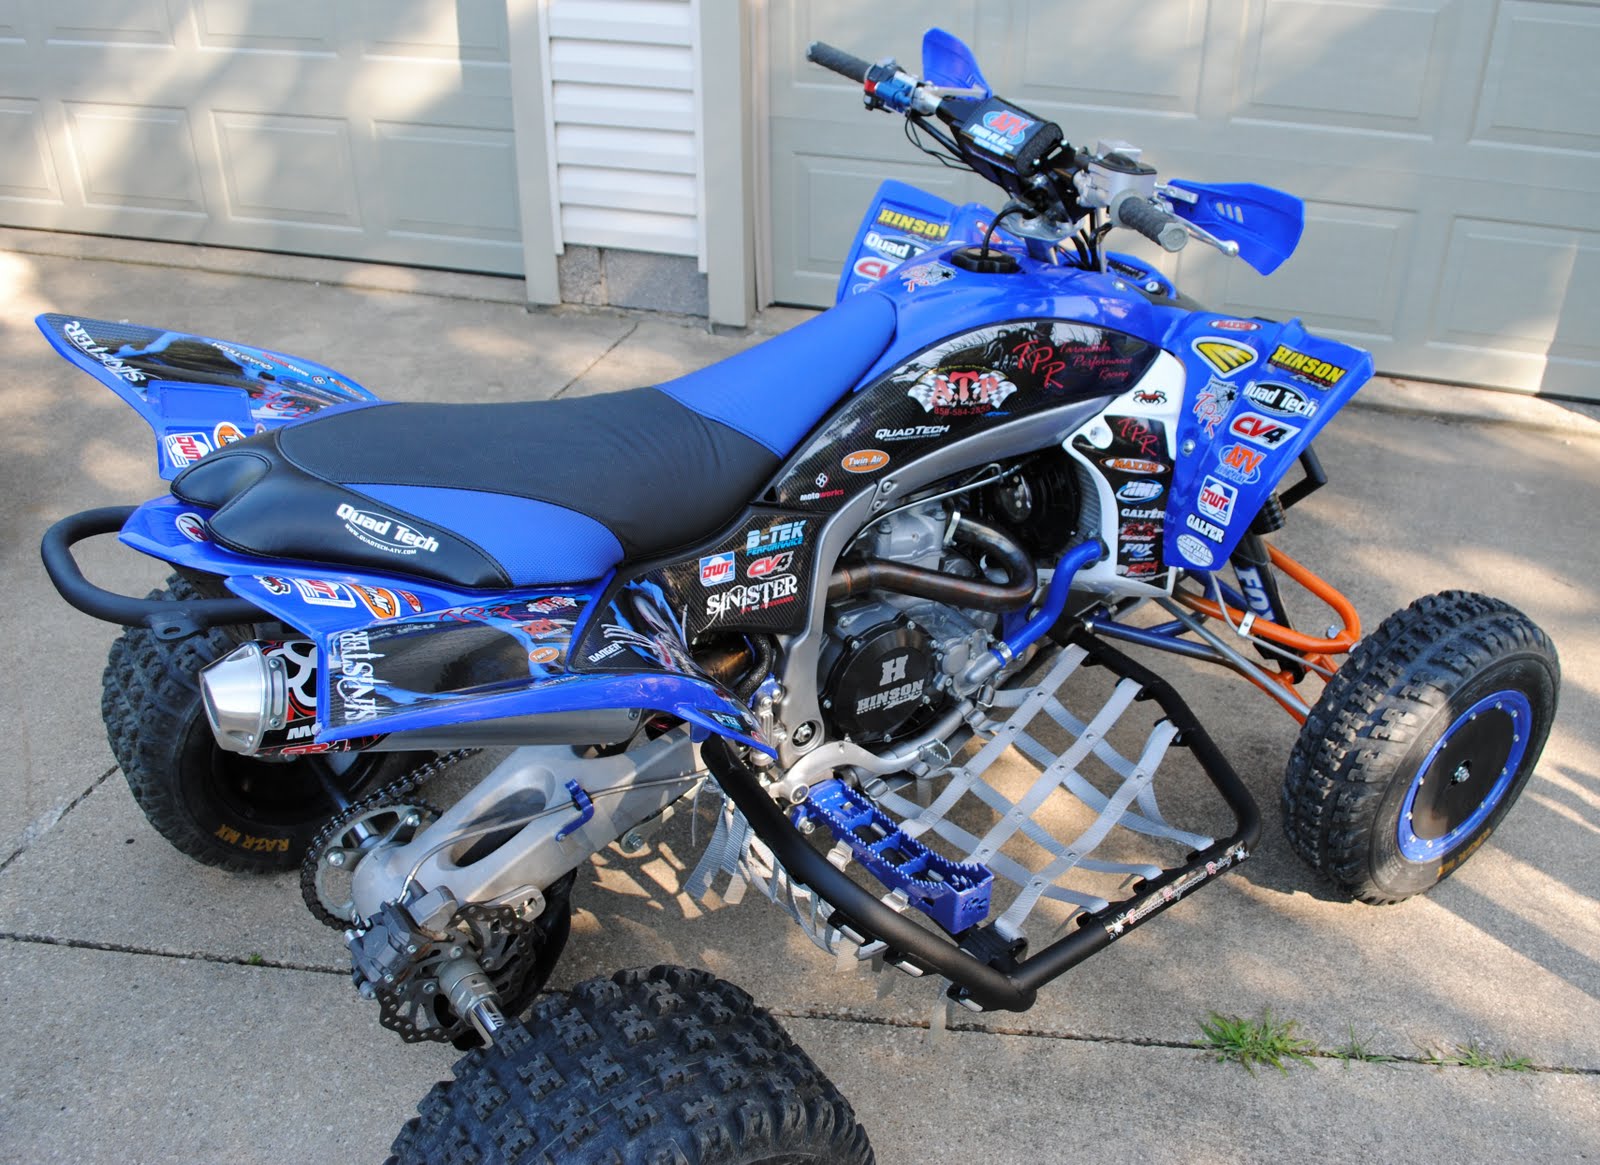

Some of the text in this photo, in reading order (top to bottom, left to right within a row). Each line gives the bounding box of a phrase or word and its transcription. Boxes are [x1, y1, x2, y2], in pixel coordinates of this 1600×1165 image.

[990, 113, 1029, 136] ATV
[1271, 345, 1347, 384] HINSON
[1242, 381, 1281, 404] Quad
[1279, 391, 1318, 417] Tech
[1117, 418, 1158, 456] TPR
[1233, 416, 1288, 444] CV4
[1113, 459, 1158, 473] MAXXIS
[1225, 445, 1263, 474] ATV
[800, 488, 844, 501] motoworks
[1201, 488, 1230, 510] DWT
[336, 503, 439, 552] Quad Tech
[746, 520, 807, 549] B-TEK
[1120, 543, 1156, 557] FOX
[702, 561, 732, 579] DWT
[703, 576, 798, 620] SINISTER
[1234, 566, 1275, 621] FO
[588, 643, 622, 663] DANGER
[337, 631, 386, 721] SINISTER
[879, 654, 909, 687] H
[857, 679, 925, 711] HINSON
[241, 833, 290, 852] RAZR
